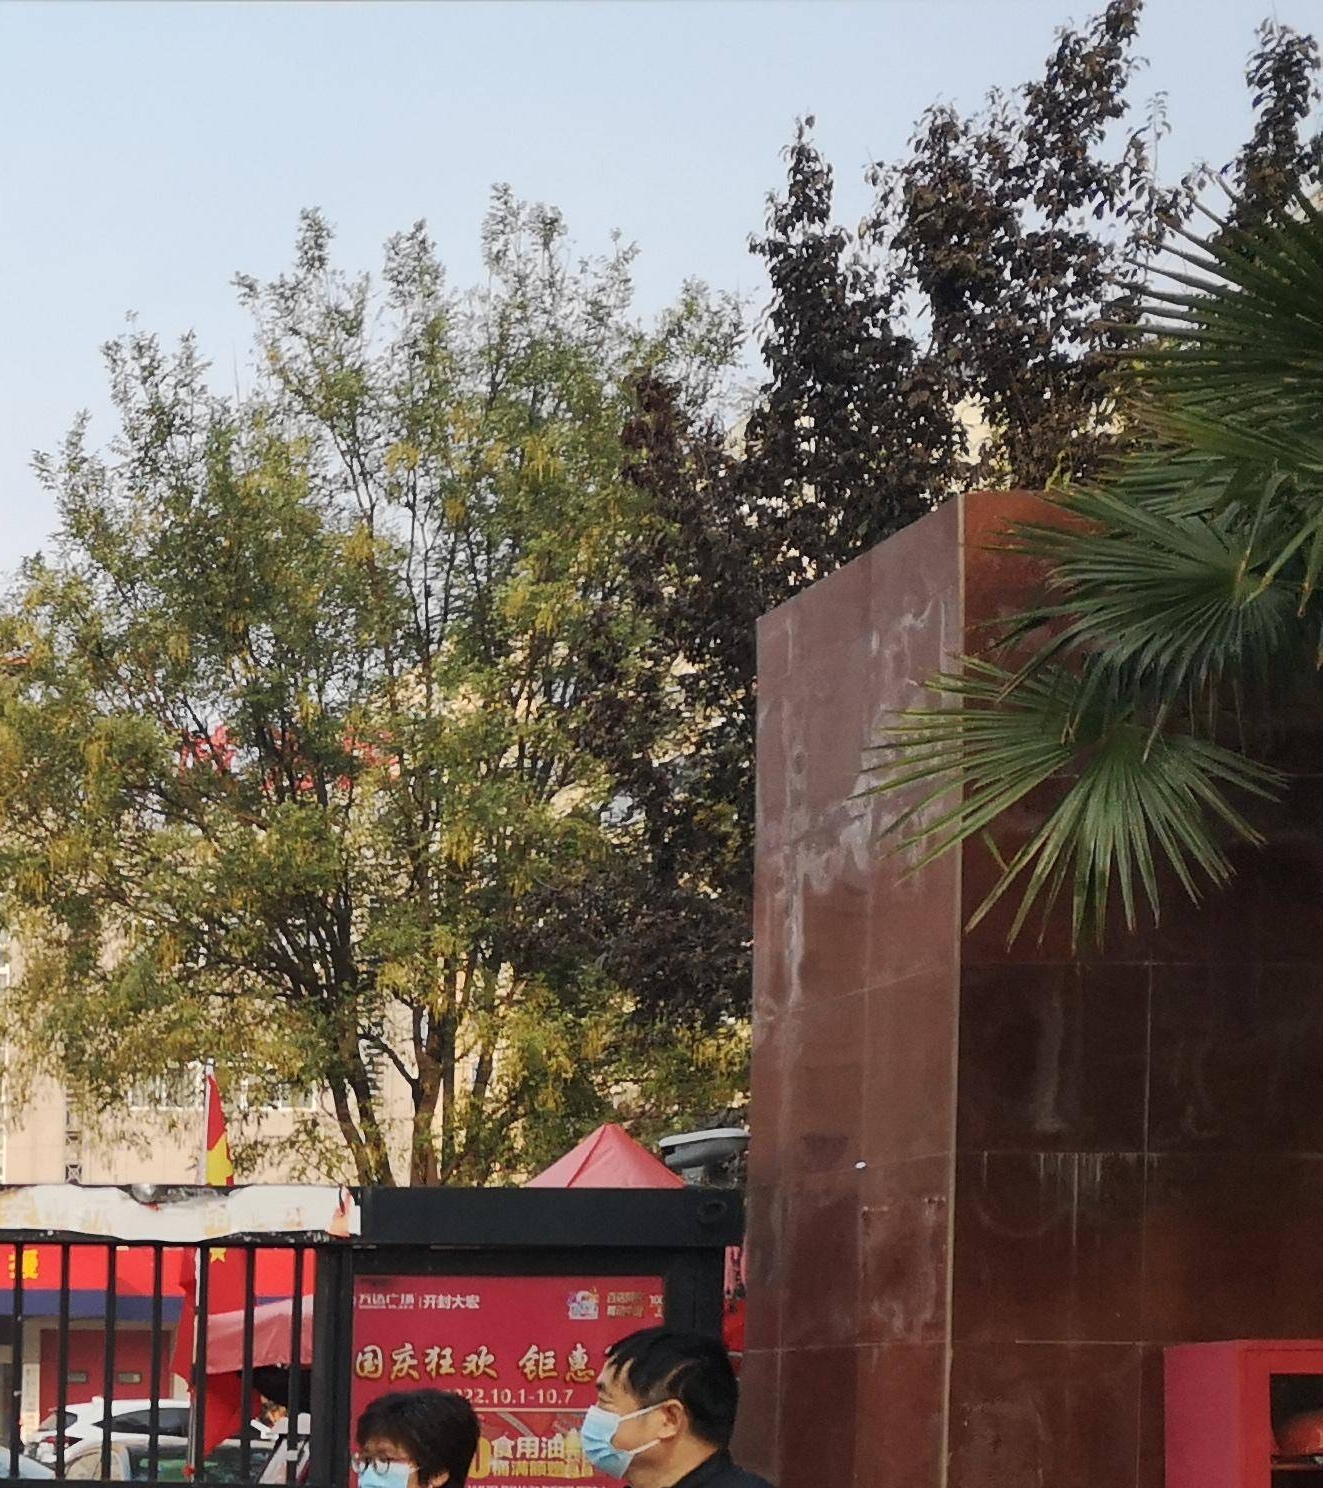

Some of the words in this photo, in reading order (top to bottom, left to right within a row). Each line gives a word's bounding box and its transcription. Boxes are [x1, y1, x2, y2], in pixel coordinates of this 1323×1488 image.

[356, 1342, 499, 1381] 国庆狂欢
[518, 1343, 612, 1382] 钜惠
[448, 1388, 574, 1404] 22.10.1-10.7
